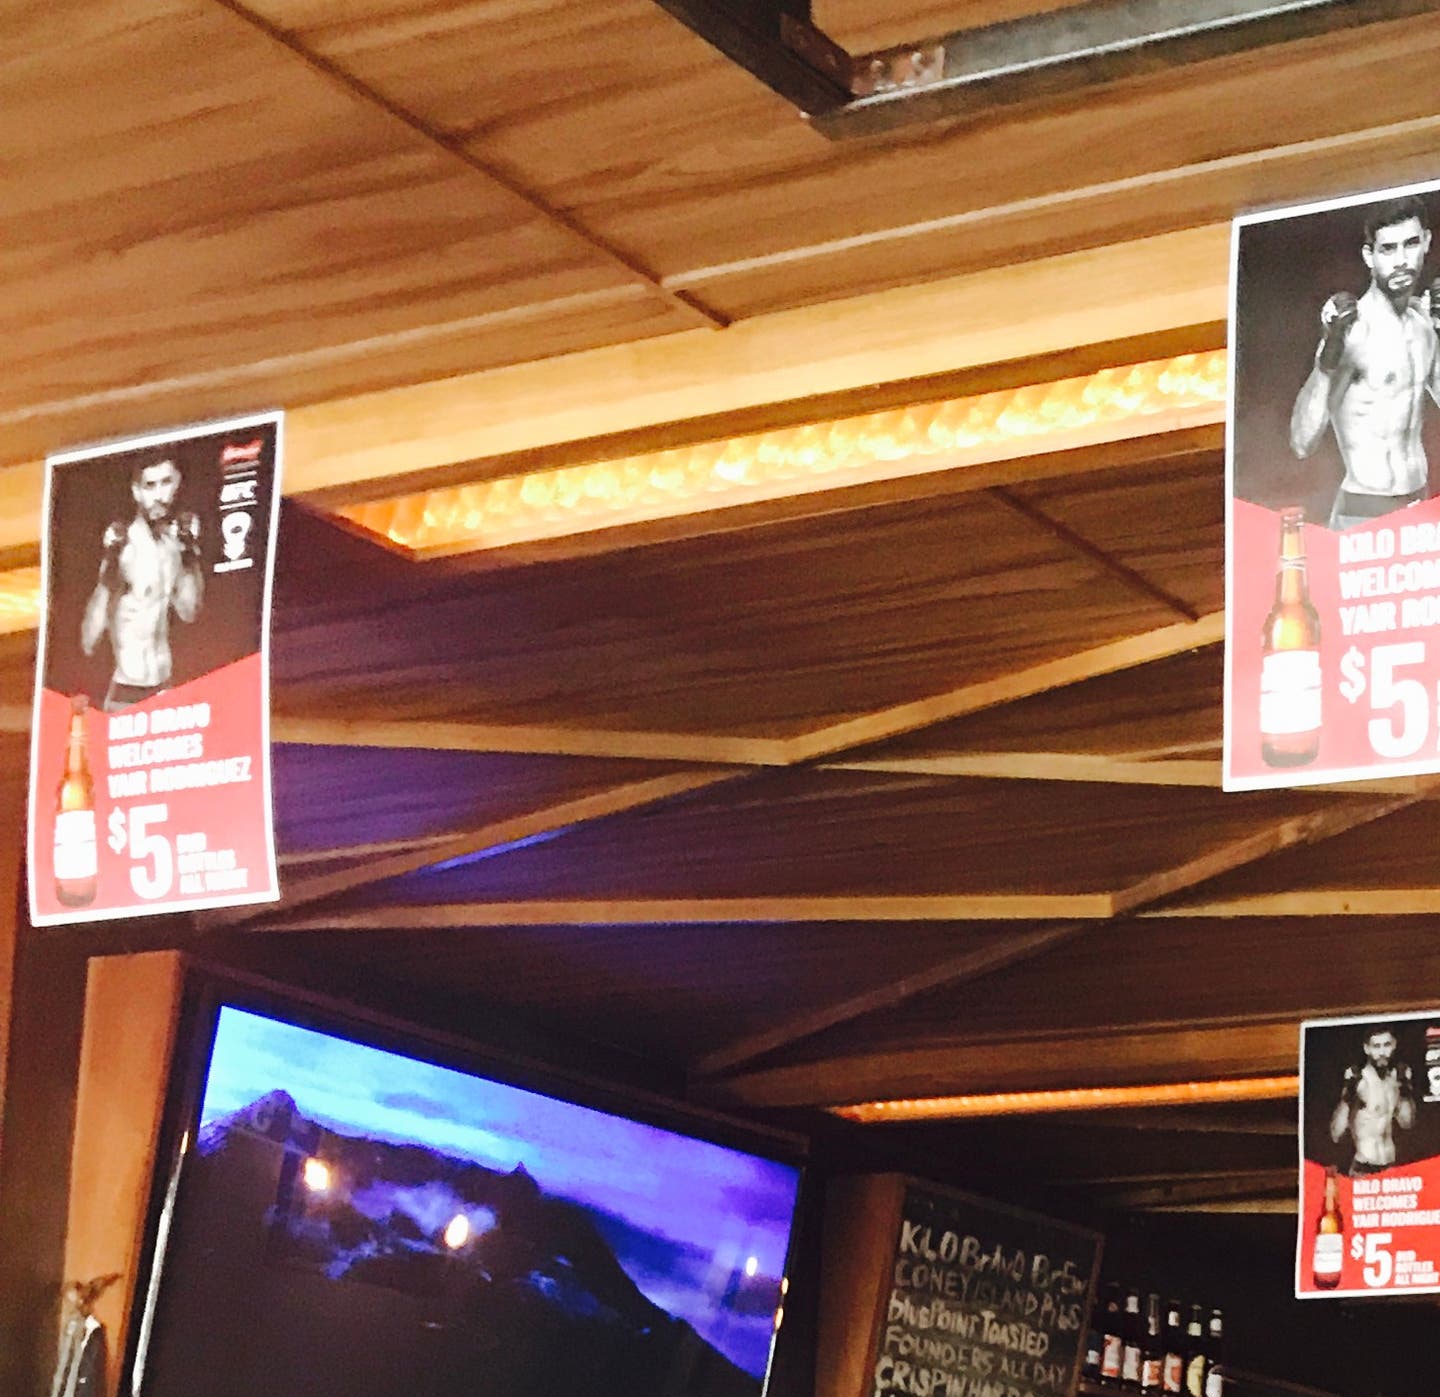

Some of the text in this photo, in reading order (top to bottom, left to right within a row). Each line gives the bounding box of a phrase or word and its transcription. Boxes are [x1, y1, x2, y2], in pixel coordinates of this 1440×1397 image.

[1339, 529, 1395, 564] KILO
[1339, 601, 1396, 636] YAIR
[1339, 641, 1429, 758] $5
[108, 733, 204, 770] WELCOMES
[107, 803, 173, 899] $5
[1353, 1176, 1423, 1195] KILO BRAVO
[1353, 1193, 1418, 1212] WELCOMES
[1352, 1213, 1380, 1229] YAIR
[895, 1257, 970, 1299] CONEY
[1351, 1232, 1393, 1287] $5
[981, 1309, 1050, 1357] TOASTED
[885, 1325, 995, 1376] FOUNDERS
[1033, 1362, 1066, 1390] DAY
